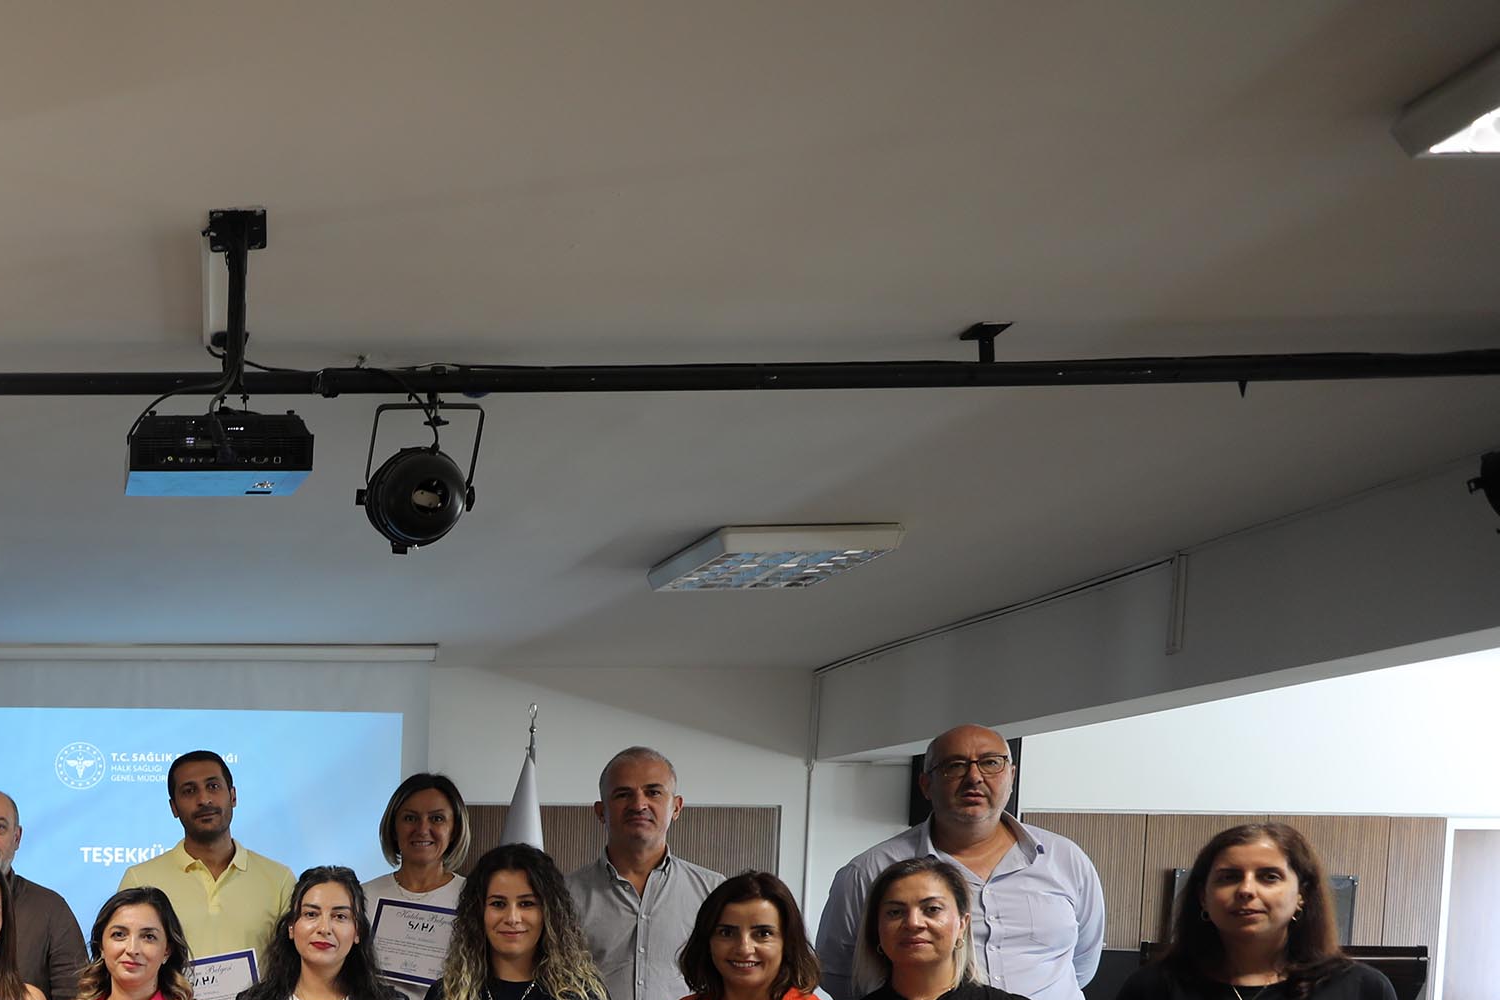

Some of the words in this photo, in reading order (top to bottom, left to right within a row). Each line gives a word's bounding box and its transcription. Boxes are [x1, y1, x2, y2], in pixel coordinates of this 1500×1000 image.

[111, 752, 130, 762] T.C.
[132, 751, 172, 762] SAĞLIK
[111, 774, 134, 782] GENEL
[137, 774, 167, 782] MÜDÜR
[80, 843, 173, 867] TEŞEKKÜ
